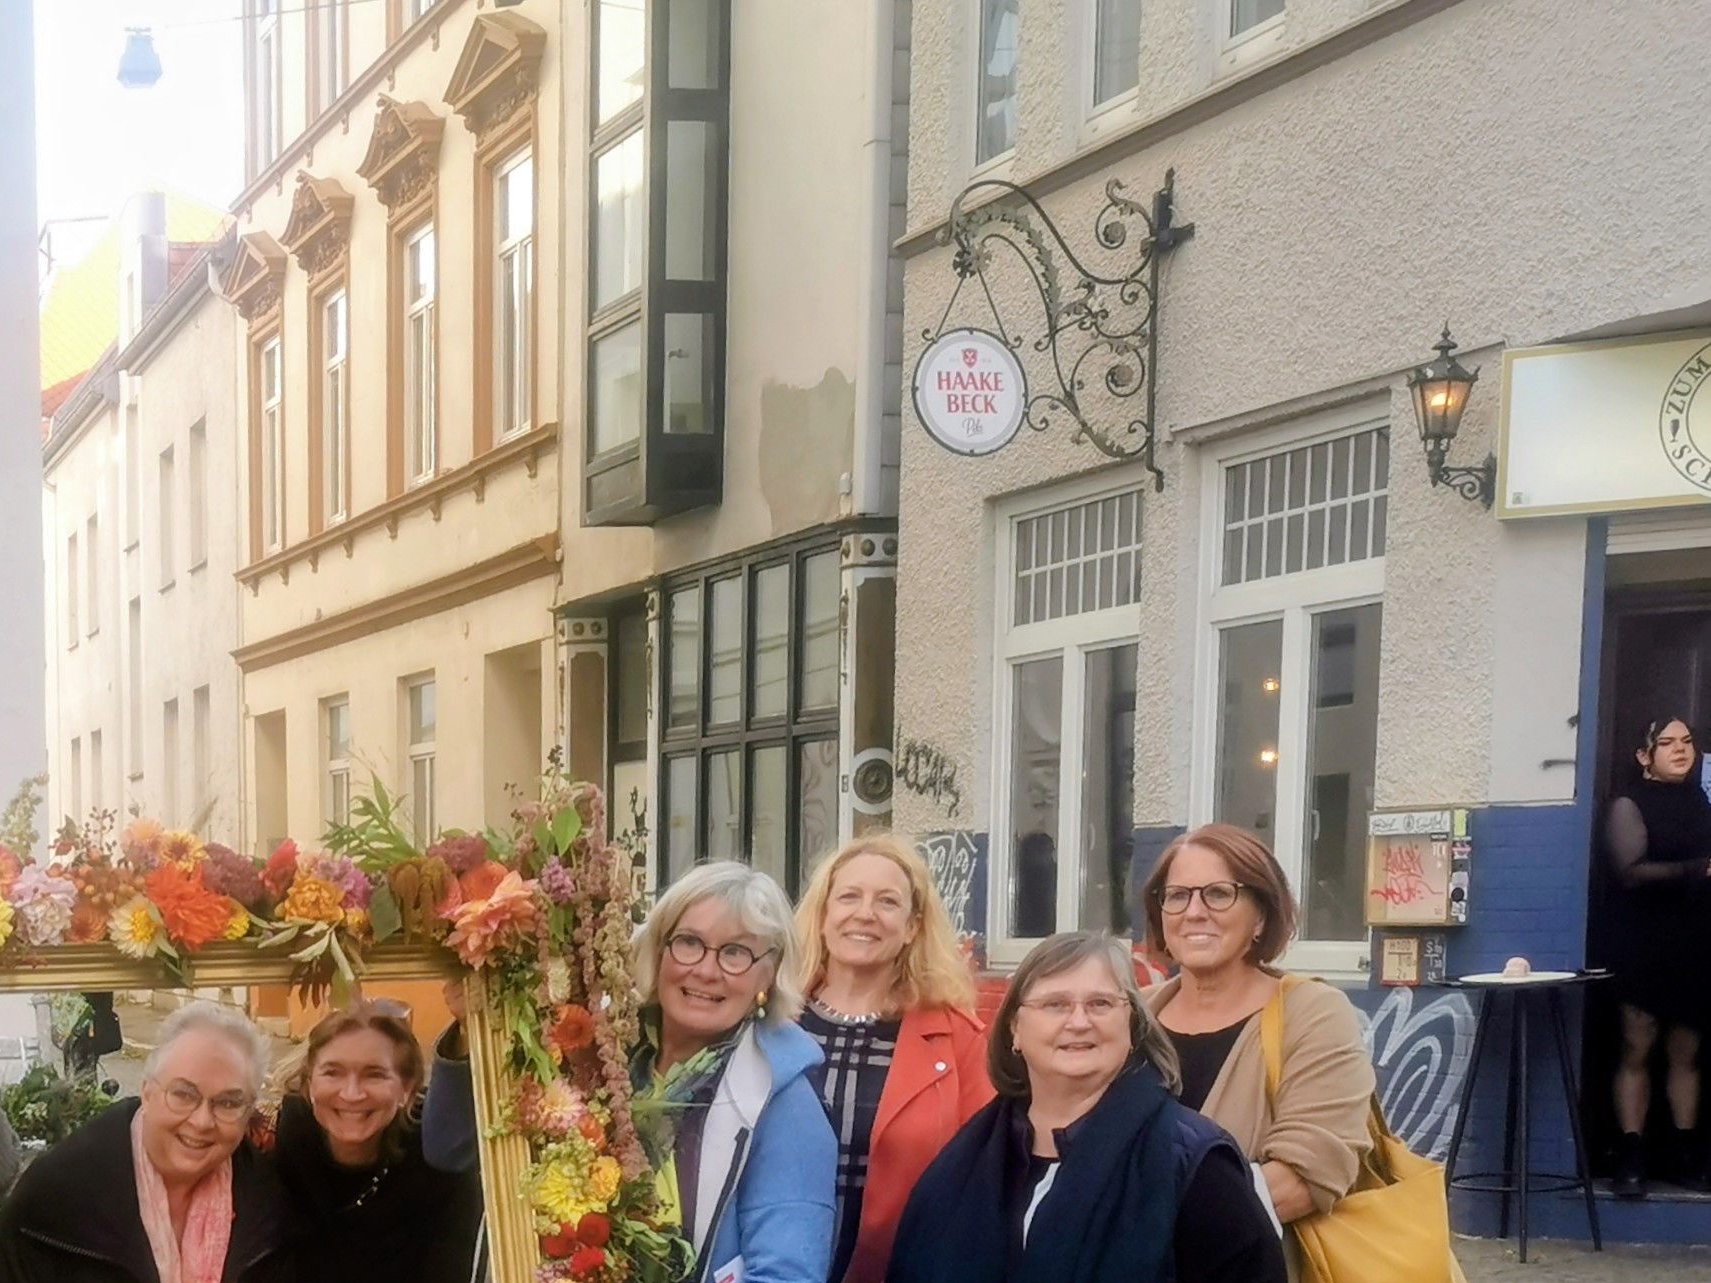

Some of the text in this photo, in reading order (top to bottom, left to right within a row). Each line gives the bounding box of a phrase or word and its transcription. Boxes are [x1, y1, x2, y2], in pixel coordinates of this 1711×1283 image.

[937, 371, 1005, 391] HAAKE
[1665, 354, 1711, 416] ZUM
[946, 394, 998, 414] BECK
